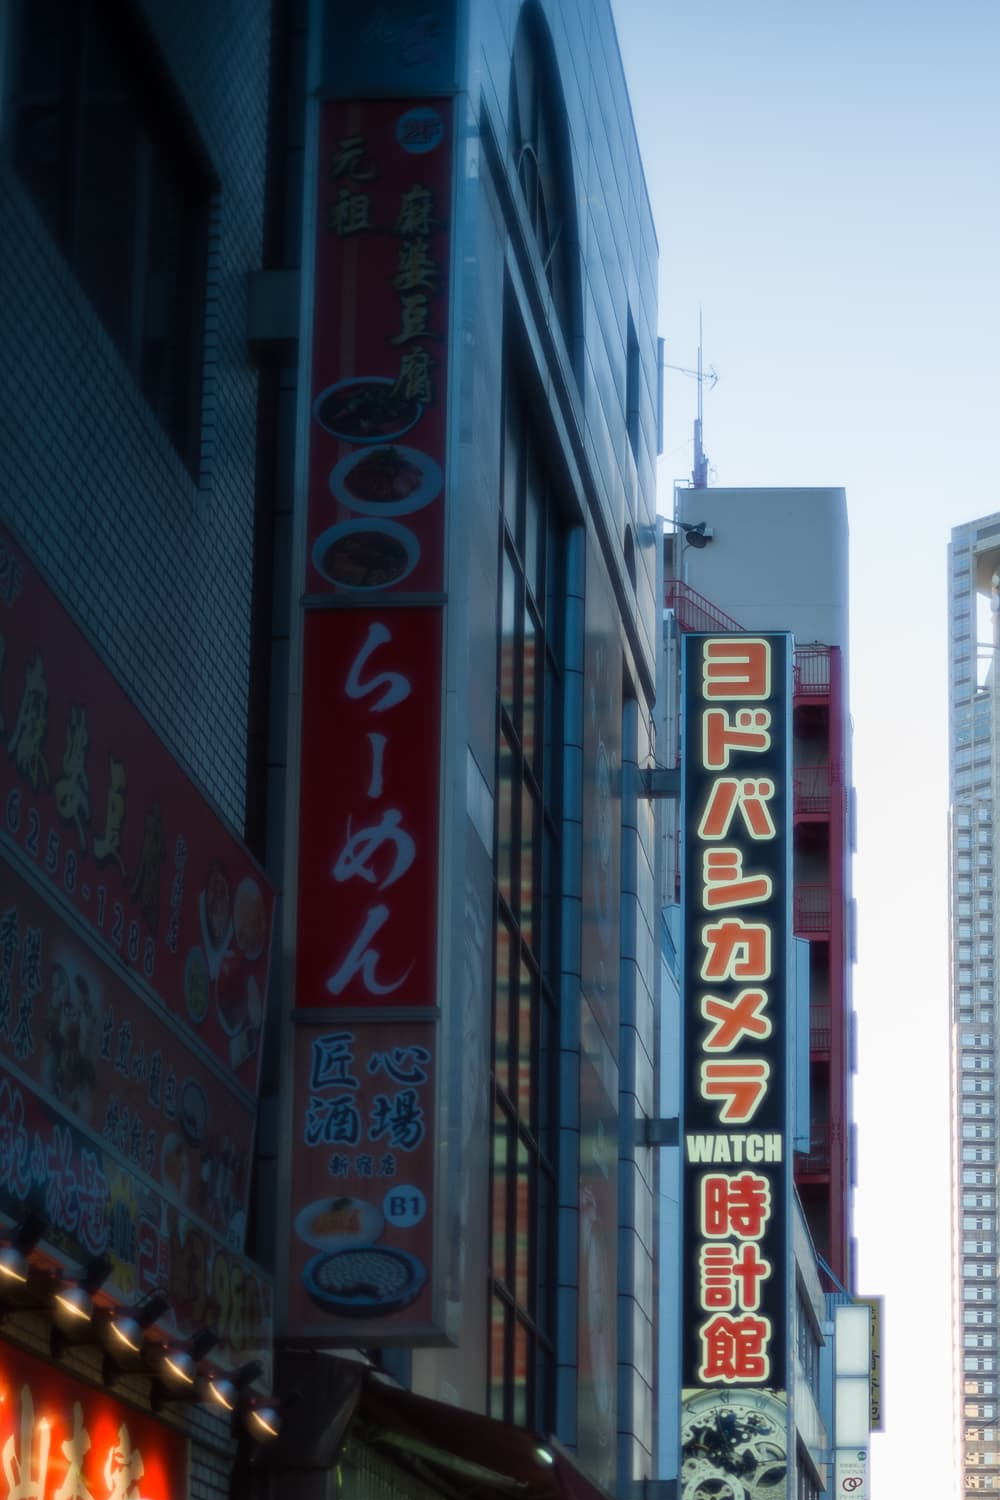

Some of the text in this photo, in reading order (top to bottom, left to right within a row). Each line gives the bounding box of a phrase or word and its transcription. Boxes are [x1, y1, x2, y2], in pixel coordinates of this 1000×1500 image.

[331, 135, 377, 236] 元祖
[393, 183, 445, 404] 麻婆豆腐
[326, 621, 418, 996] らーめん
[698, 637, 776, 1124] ヨドバシカメラ
[310, 1031, 432, 1092] 匠心
[304, 1087, 426, 1153] 酒場
[686, 1134, 782, 1164] WATCH
[327, 1153, 398, 1178] 新宿店
[390, 1196, 420, 1216] B1
[699, 1171, 772, 1384] 時計館
